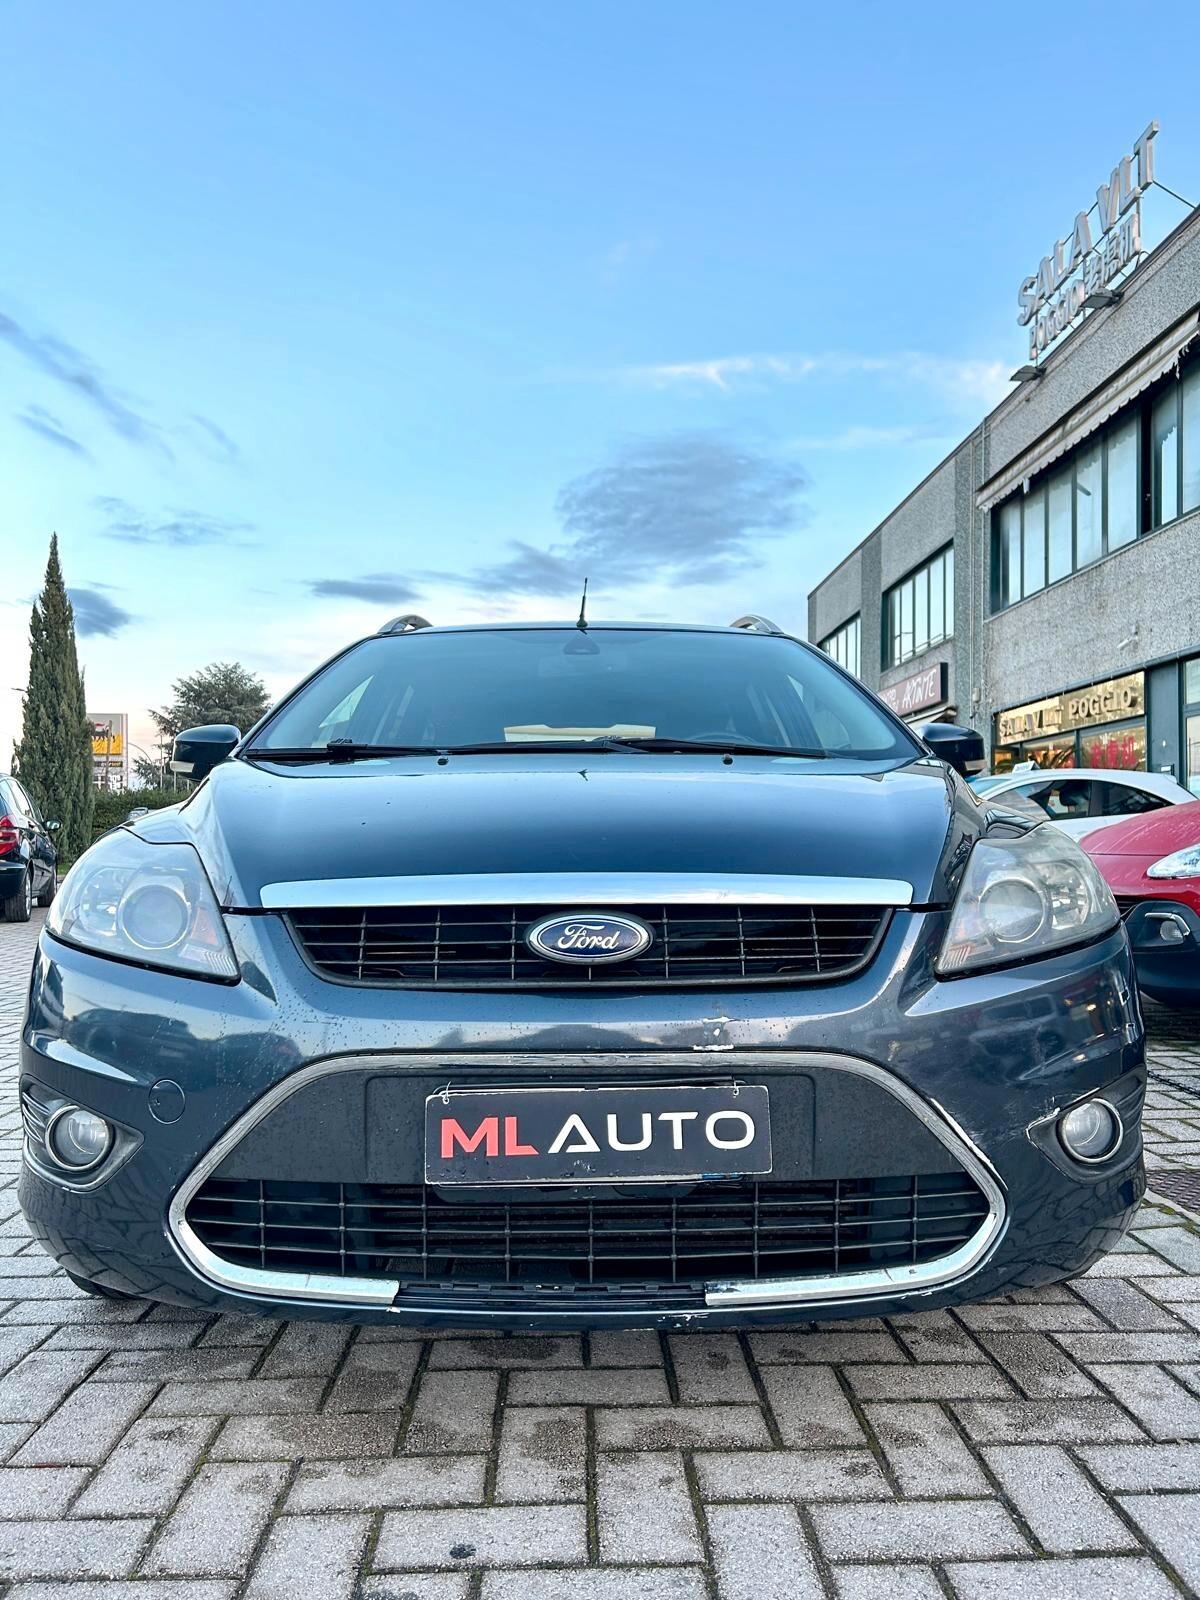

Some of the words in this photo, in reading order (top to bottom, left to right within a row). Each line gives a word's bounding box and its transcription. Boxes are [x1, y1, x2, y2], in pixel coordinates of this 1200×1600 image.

[1017, 211, 1093, 326] SALA
[1096, 119, 1158, 234] VLT
[1029, 279, 1085, 360] POGGIO
[1069, 686, 1134, 719] POGGIO
[557, 923, 619, 949] Ford
